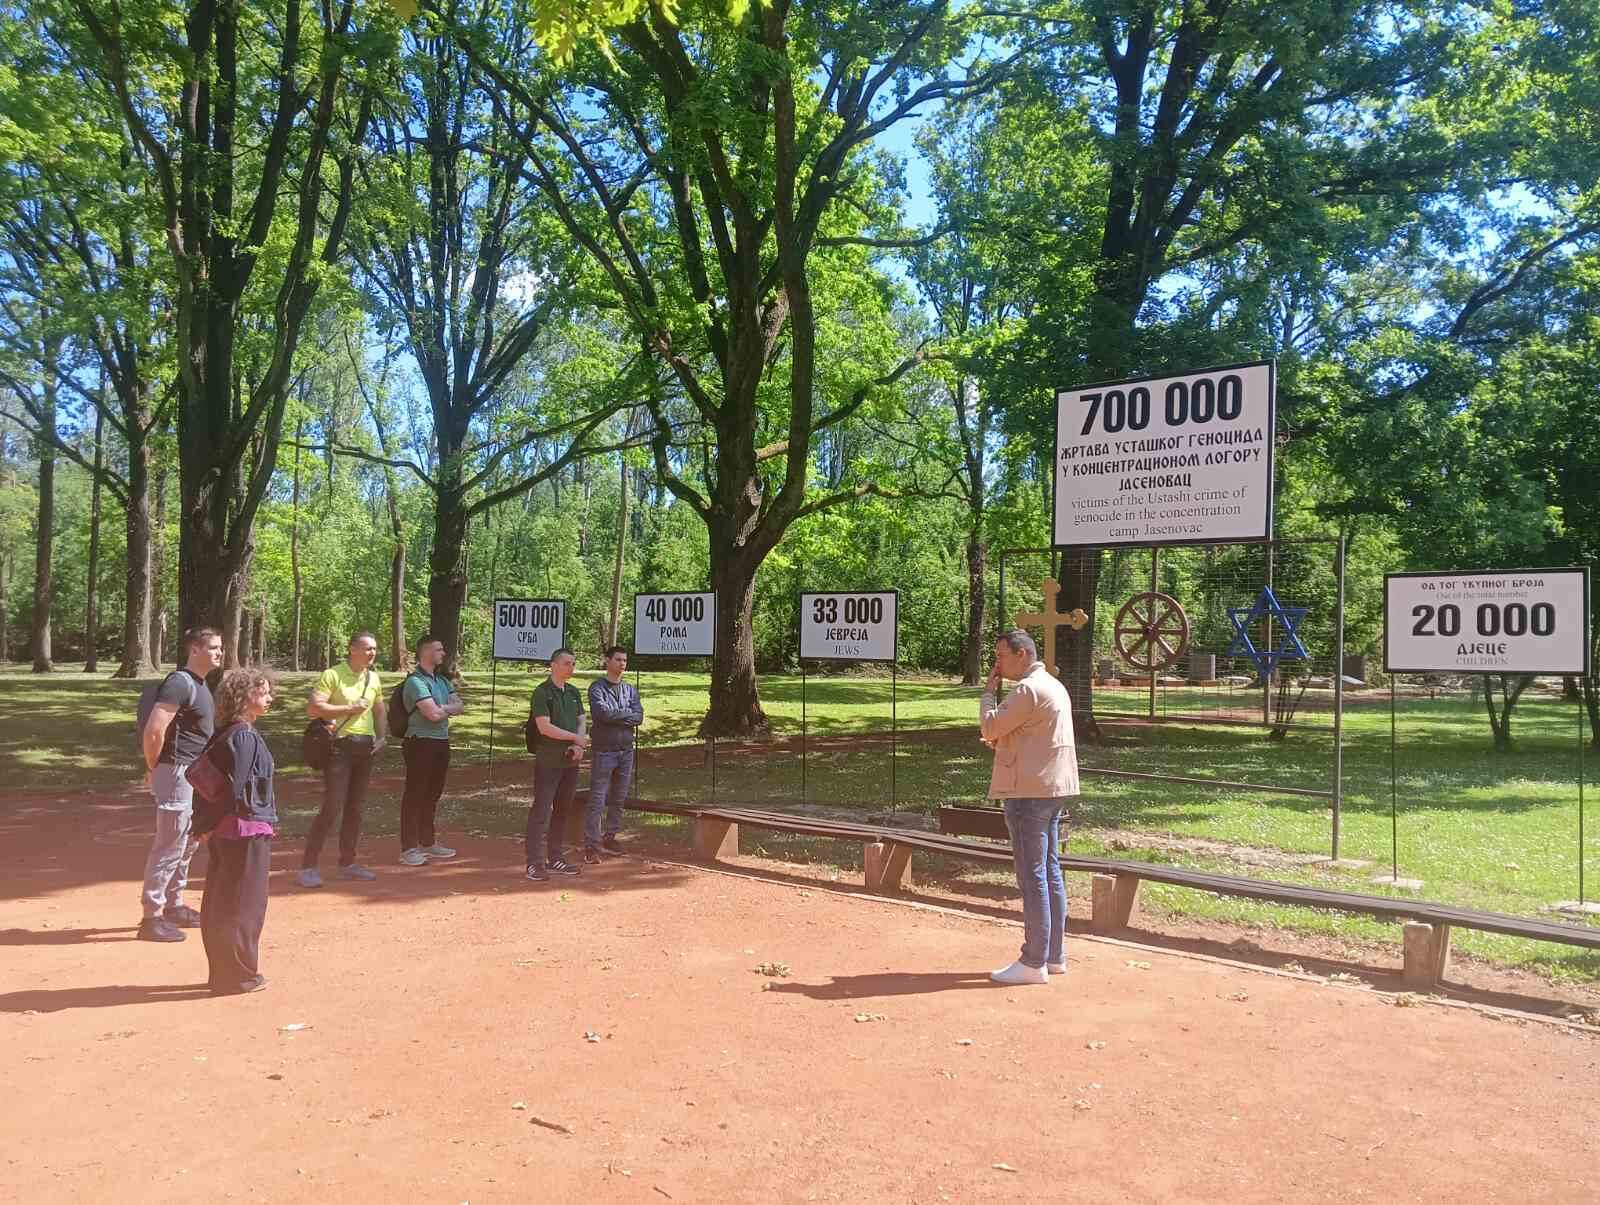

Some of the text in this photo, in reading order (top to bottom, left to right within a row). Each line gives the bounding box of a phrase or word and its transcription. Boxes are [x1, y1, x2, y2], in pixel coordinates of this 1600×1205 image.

[1080, 374, 1242, 436] 700 000
[1060, 428, 1262, 460] ЖРТАВА УСТАШКОГ ГЕНОЦИДА
[1062, 448, 1261, 477] У КОНЦЕНТРАЦИОНОМ ЛОГОРУ
[1119, 473, 1192, 491] ЈАСЕНОВАЦ
[1072, 486, 1246, 508] victims of the Ustashi crime of
[1074, 502, 1241, 526] genocide in the concentration
[1110, 523, 1202, 540] camp Jasenovac
[1422, 578, 1544, 590] ОД ТОГ УКУПНОГ БРОЈА
[500, 604, 560, 628] 500 000
[645, 596, 704, 622] 40 000
[813, 598, 882, 624] 33 000
[1412, 602, 1556, 636] 20 000
[517, 632, 538, 644] СРБА
[660, 626, 688, 638] РОМА
[825, 628, 868, 640] ЈЕВРЕЈА
[834, 645, 860, 656] JEWS
[1457, 643, 1507, 655] ДЈЕЦЕ
